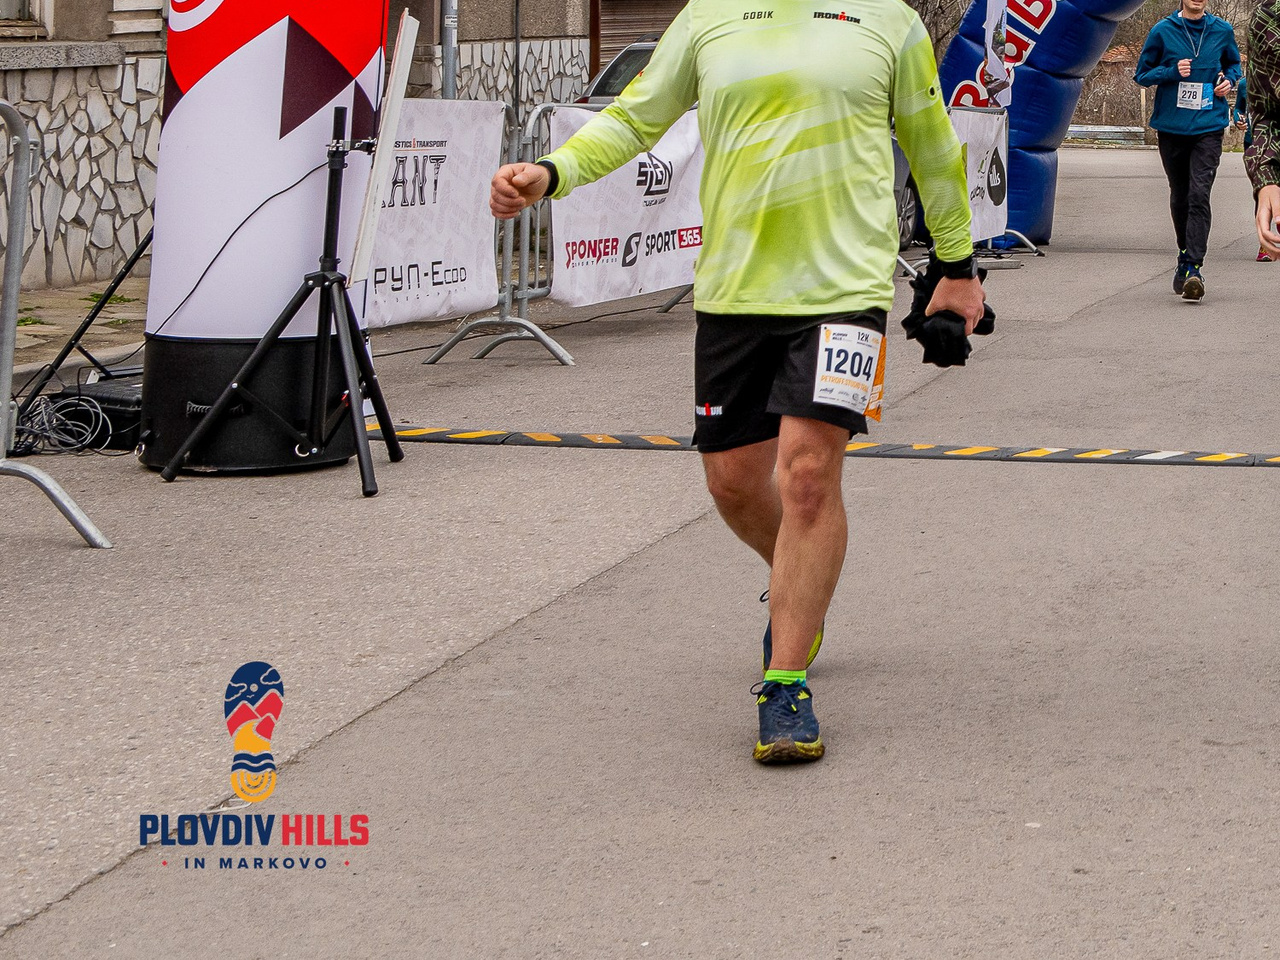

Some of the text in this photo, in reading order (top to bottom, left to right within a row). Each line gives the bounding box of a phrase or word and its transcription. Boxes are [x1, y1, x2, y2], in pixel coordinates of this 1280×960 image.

[743, 10, 774, 20] GOBIK
[1181, 90, 1198, 100] 278
[416, 140, 448, 148] TRANSPORT
[645, 230, 677, 256] SPORT
[565, 237, 619, 269] SPONSER
[857, 332, 870, 343] 12K
[825, 347, 874, 381] 1204
